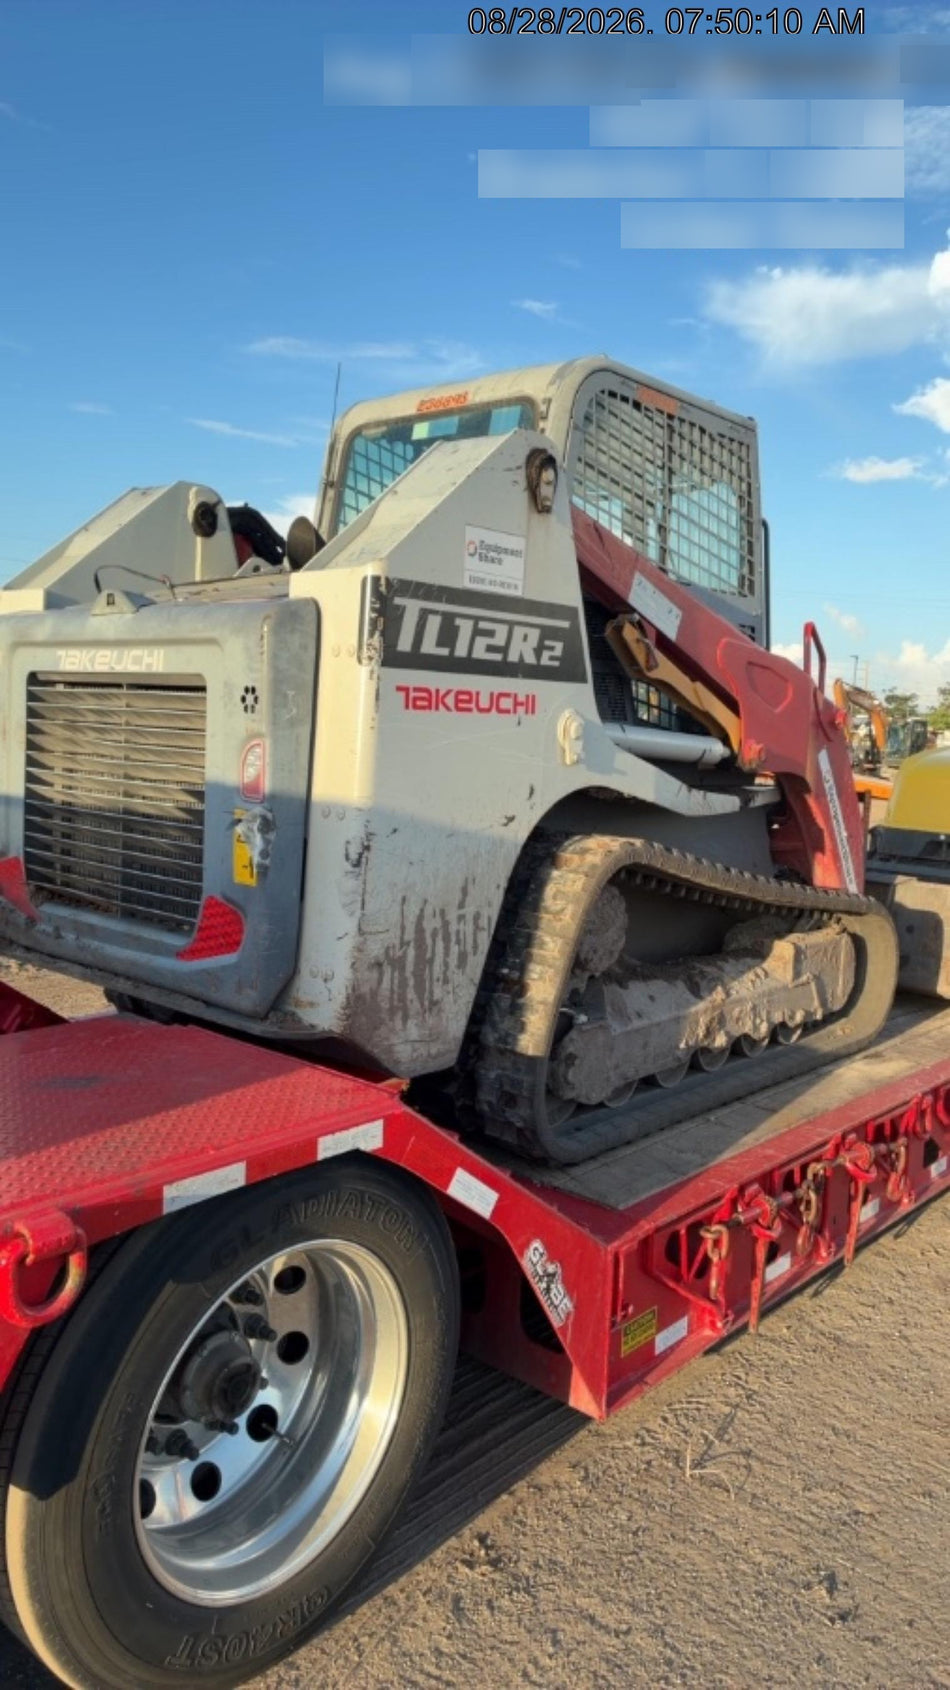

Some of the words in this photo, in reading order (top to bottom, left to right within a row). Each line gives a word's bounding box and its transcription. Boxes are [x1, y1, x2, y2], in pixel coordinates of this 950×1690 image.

[393, 597, 571, 667] TL12R2
[57, 648, 164, 672] TAKEUCHI
[395, 685, 536, 715] TAKEUCHI
[209, 1187, 418, 1271] GLADIATOR
